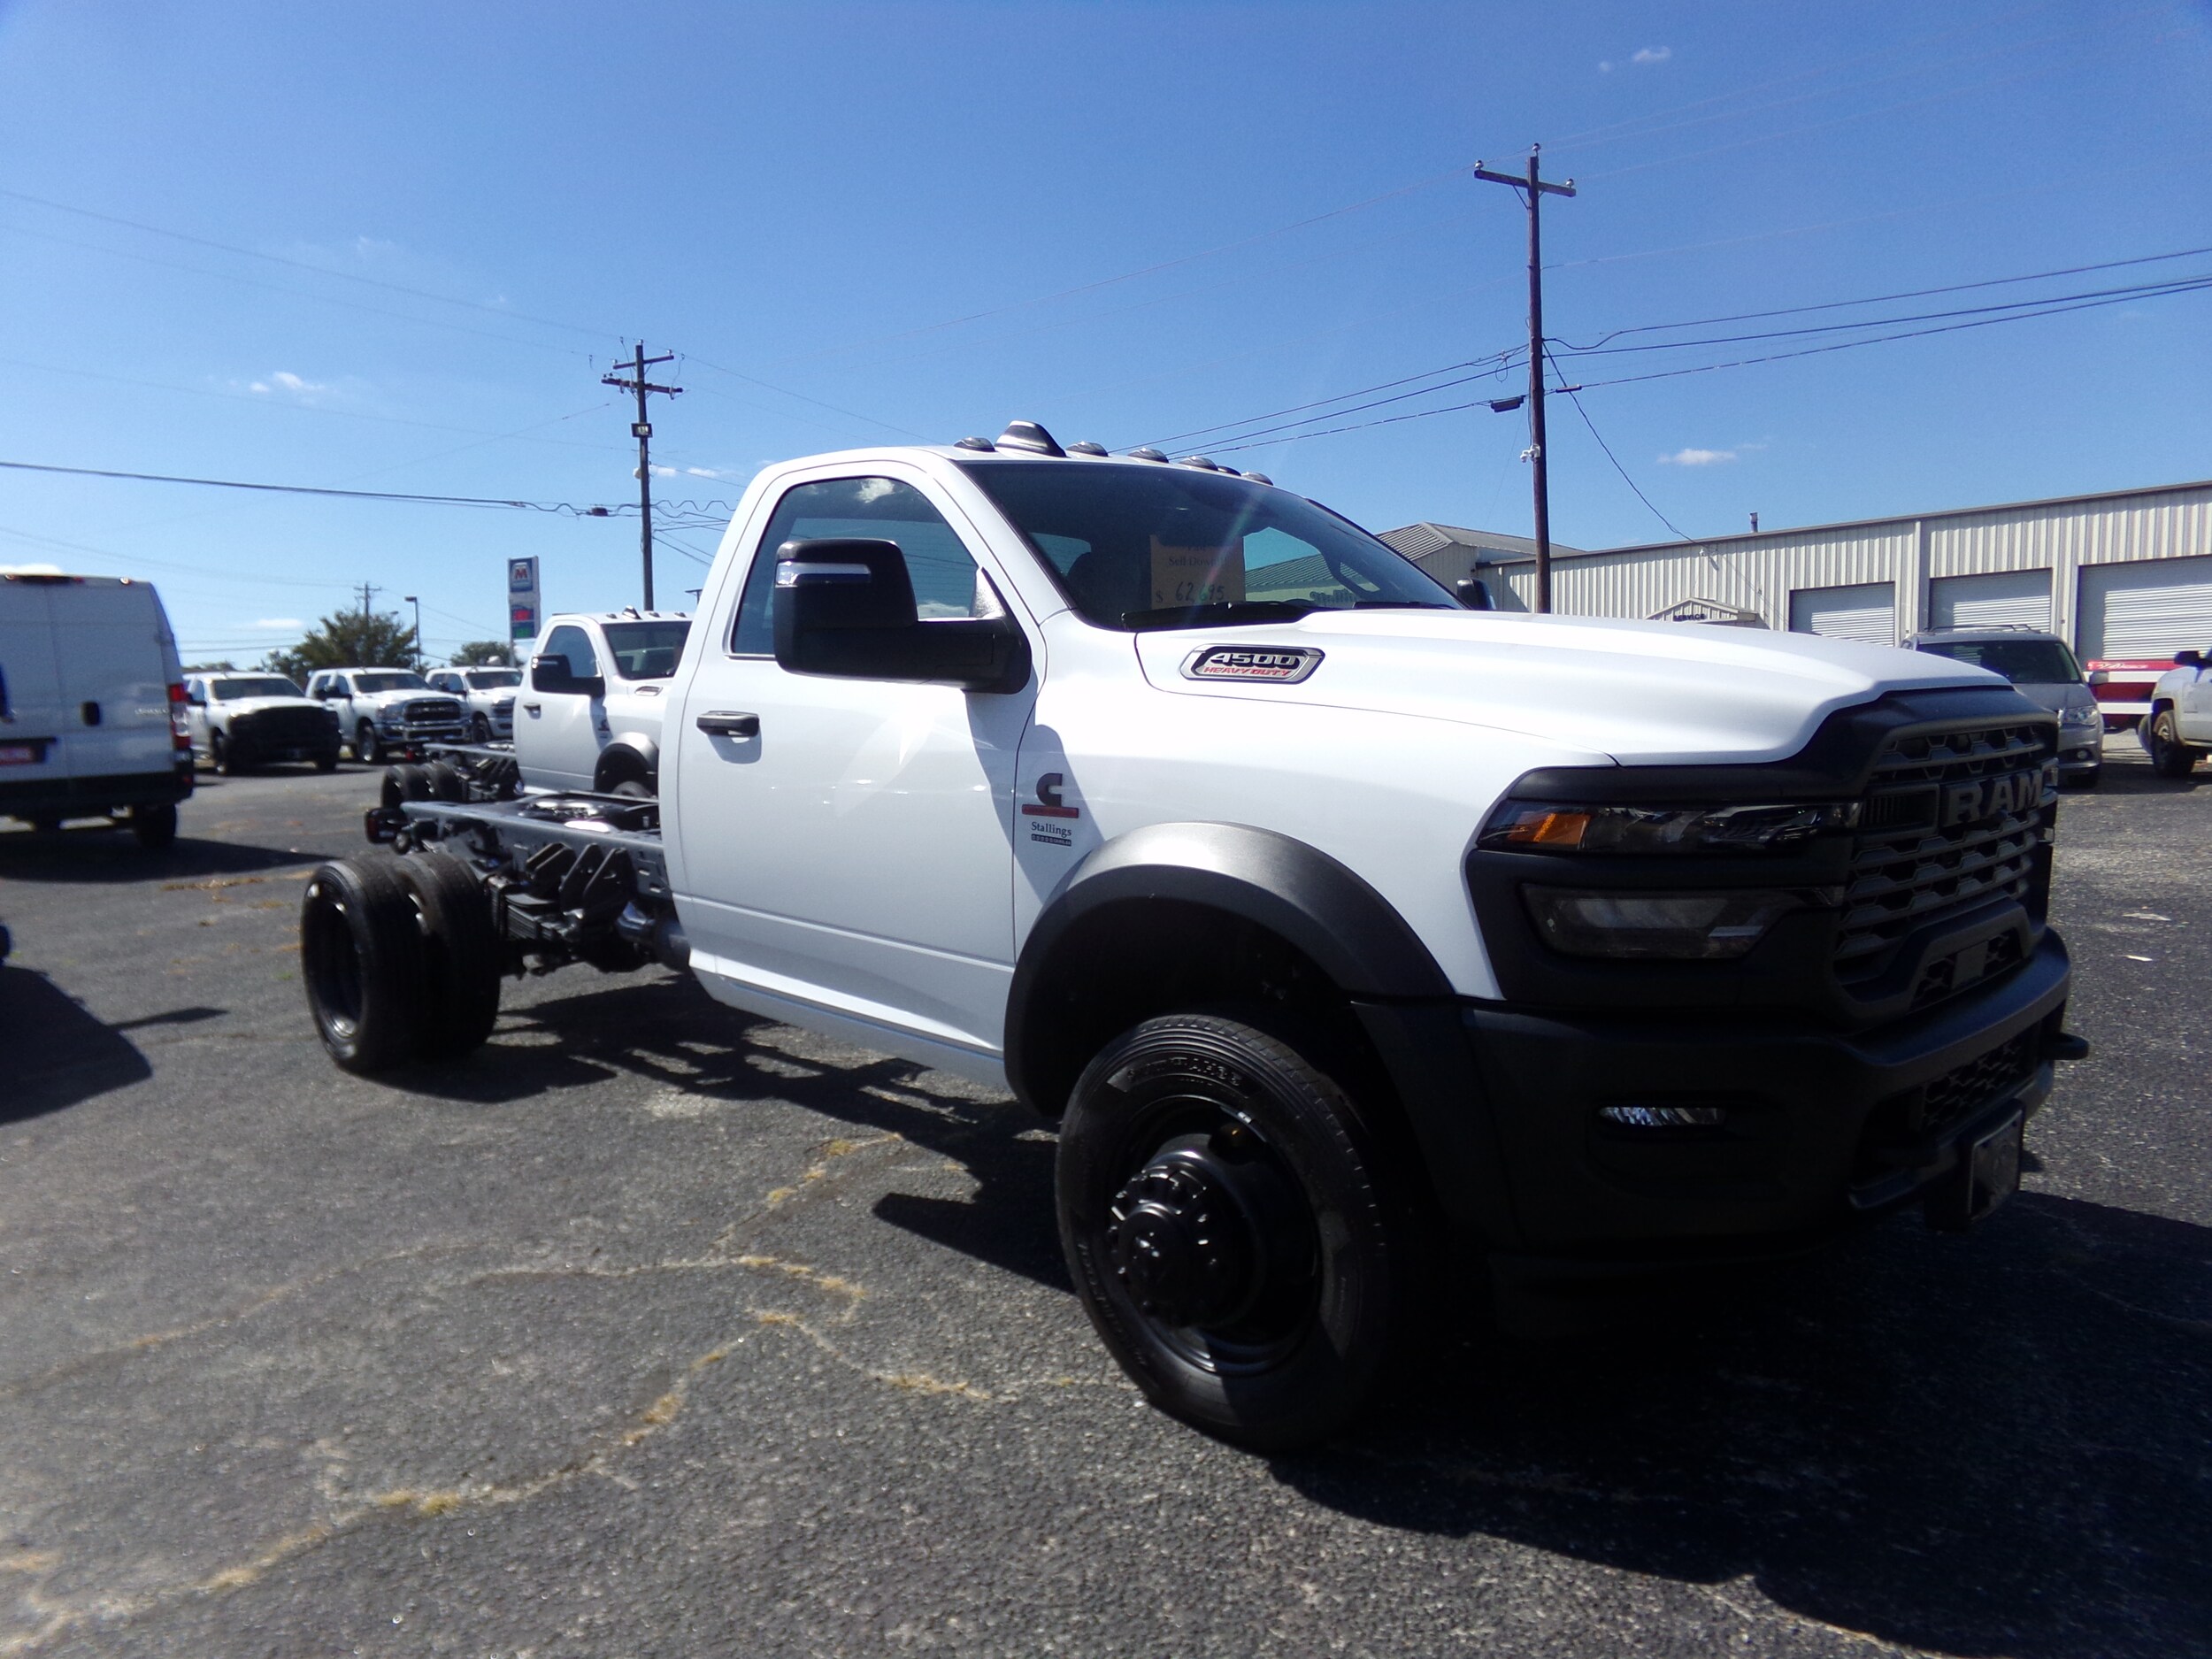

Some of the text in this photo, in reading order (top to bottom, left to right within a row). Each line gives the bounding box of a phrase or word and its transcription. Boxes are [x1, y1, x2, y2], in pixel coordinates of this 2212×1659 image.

[1210, 652, 1301, 670] 4500
[1203, 666, 1252, 675] HEAVY
[1942, 768, 2044, 827] RAM
[1031, 821, 1072, 838] Stallings
